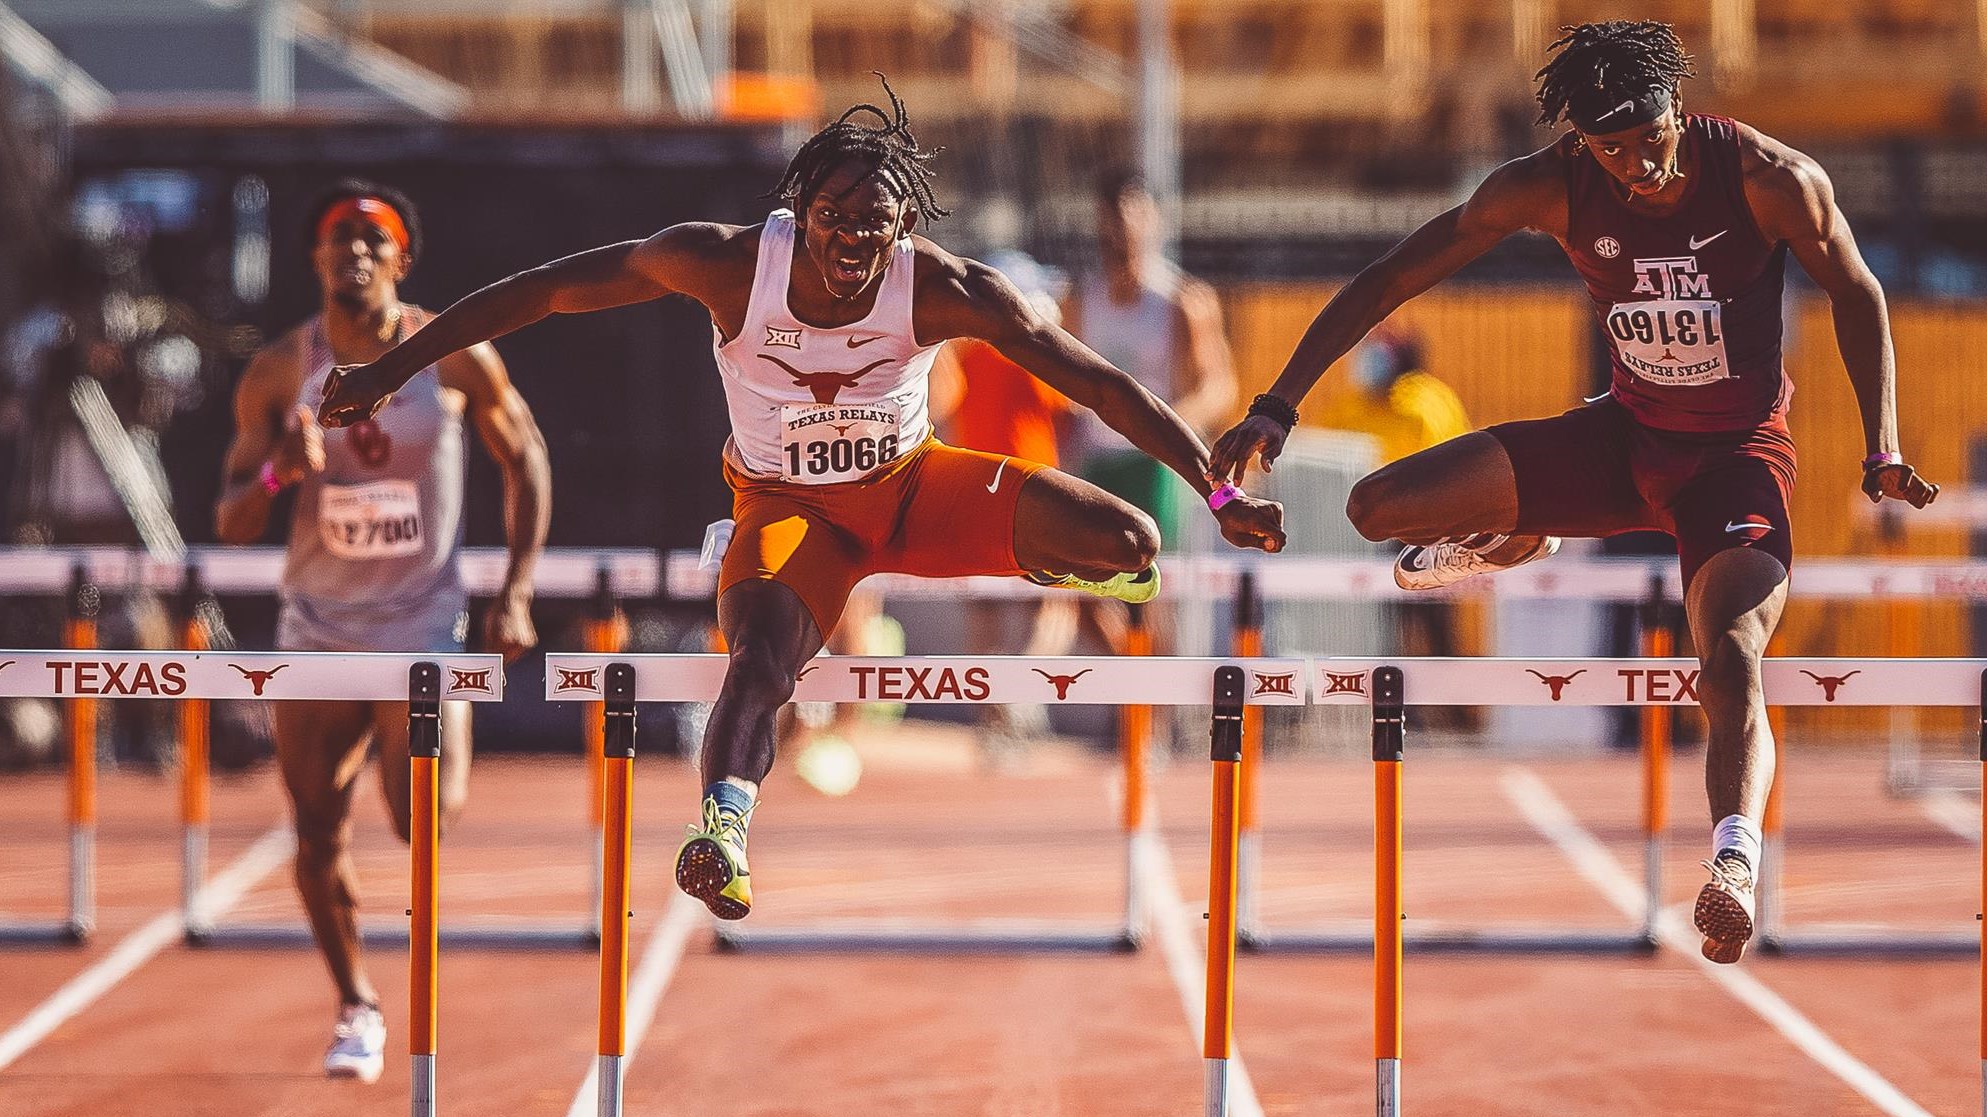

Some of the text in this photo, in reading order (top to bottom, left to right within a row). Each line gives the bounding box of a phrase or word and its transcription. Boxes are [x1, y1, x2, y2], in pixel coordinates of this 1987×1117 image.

[1596, 238, 1617, 257] SEC
[765, 327, 801, 349] XII
[1609, 309, 1721, 346] 13160
[1624, 352, 1721, 378] TEXAS RELAYS
[788, 409, 895, 431] TEXAS RELAYS
[784, 434, 898, 477] 13066
[46, 661, 187, 696] TEXAS
[450, 669, 491, 692] XII
[557, 669, 598, 692] XII
[849, 667, 991, 701] TEXAS
[1254, 673, 1294, 695] XII
[1325, 672, 1366, 694] XII
[1618, 669, 1701, 702] TEX
